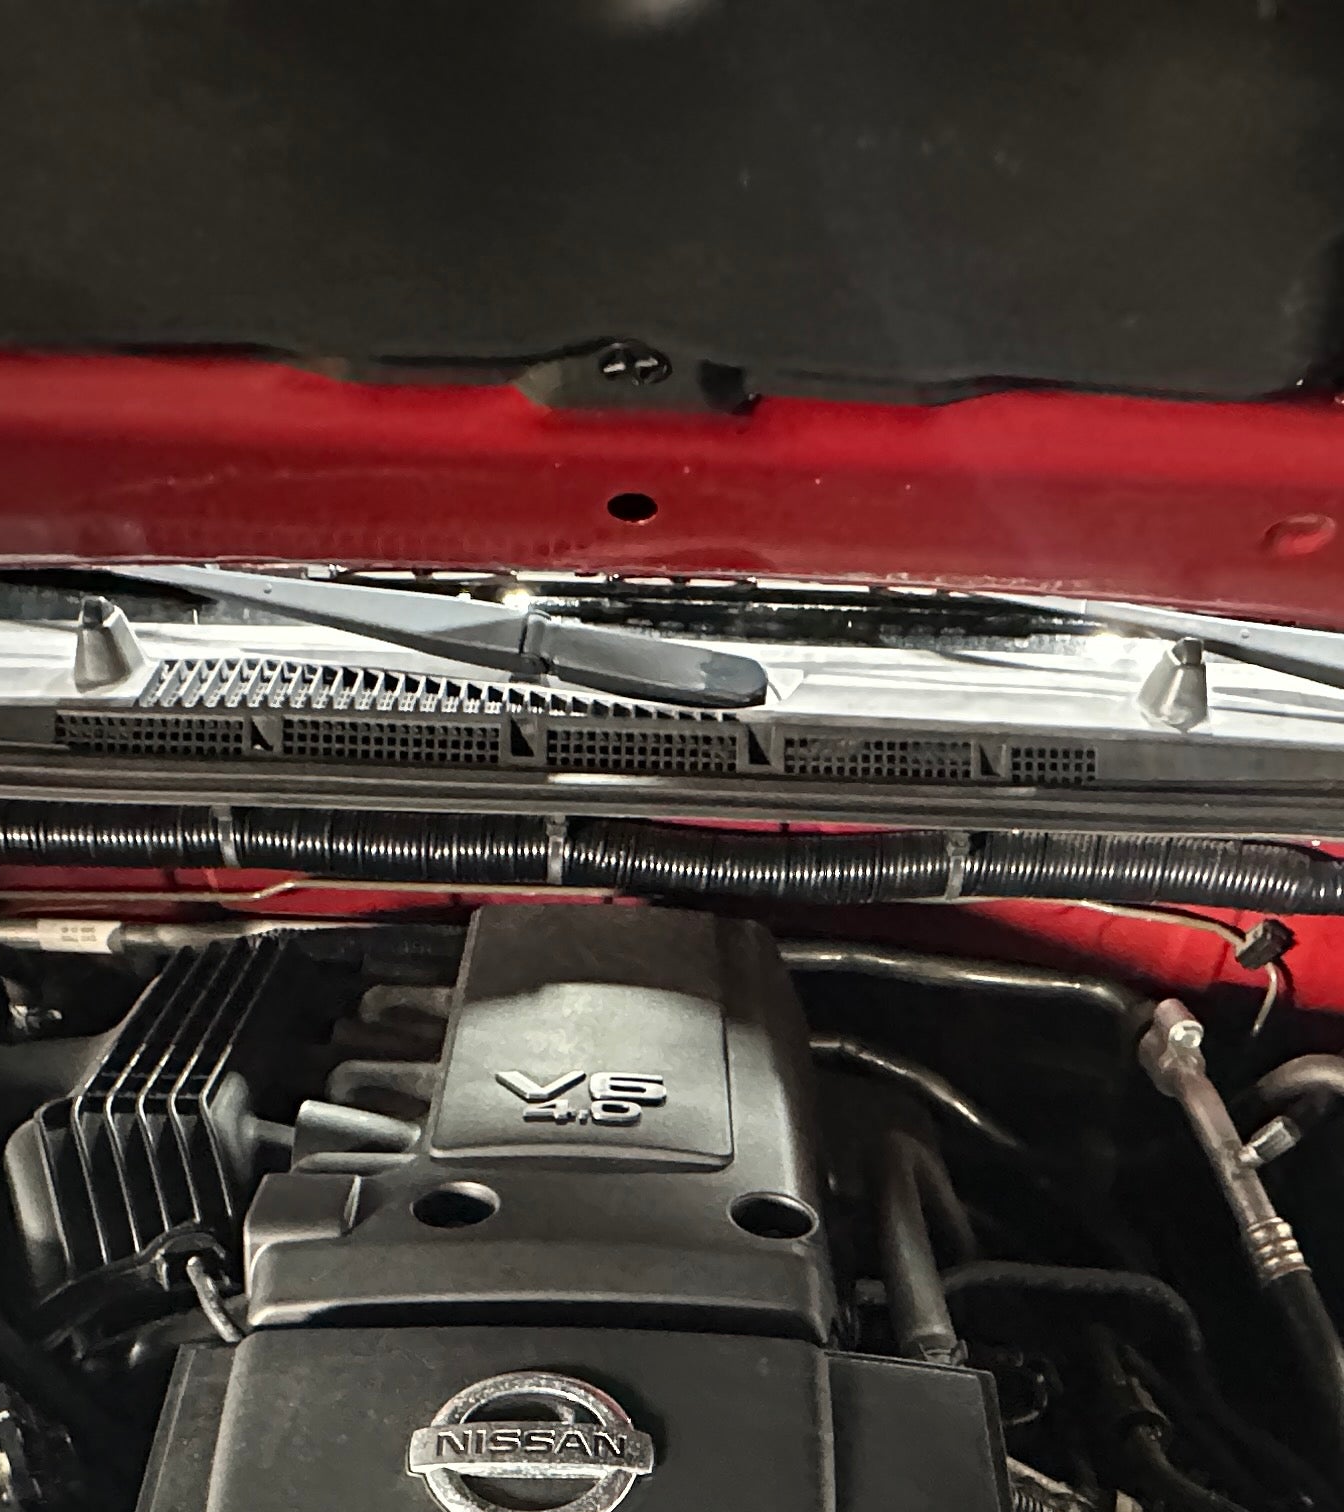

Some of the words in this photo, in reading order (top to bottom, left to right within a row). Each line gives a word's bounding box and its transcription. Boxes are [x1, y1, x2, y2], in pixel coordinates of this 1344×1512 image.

[495, 1069, 667, 1106] V6
[523, 1099, 642, 1127] 4.0
[435, 1428, 628, 1458] NISSAN
